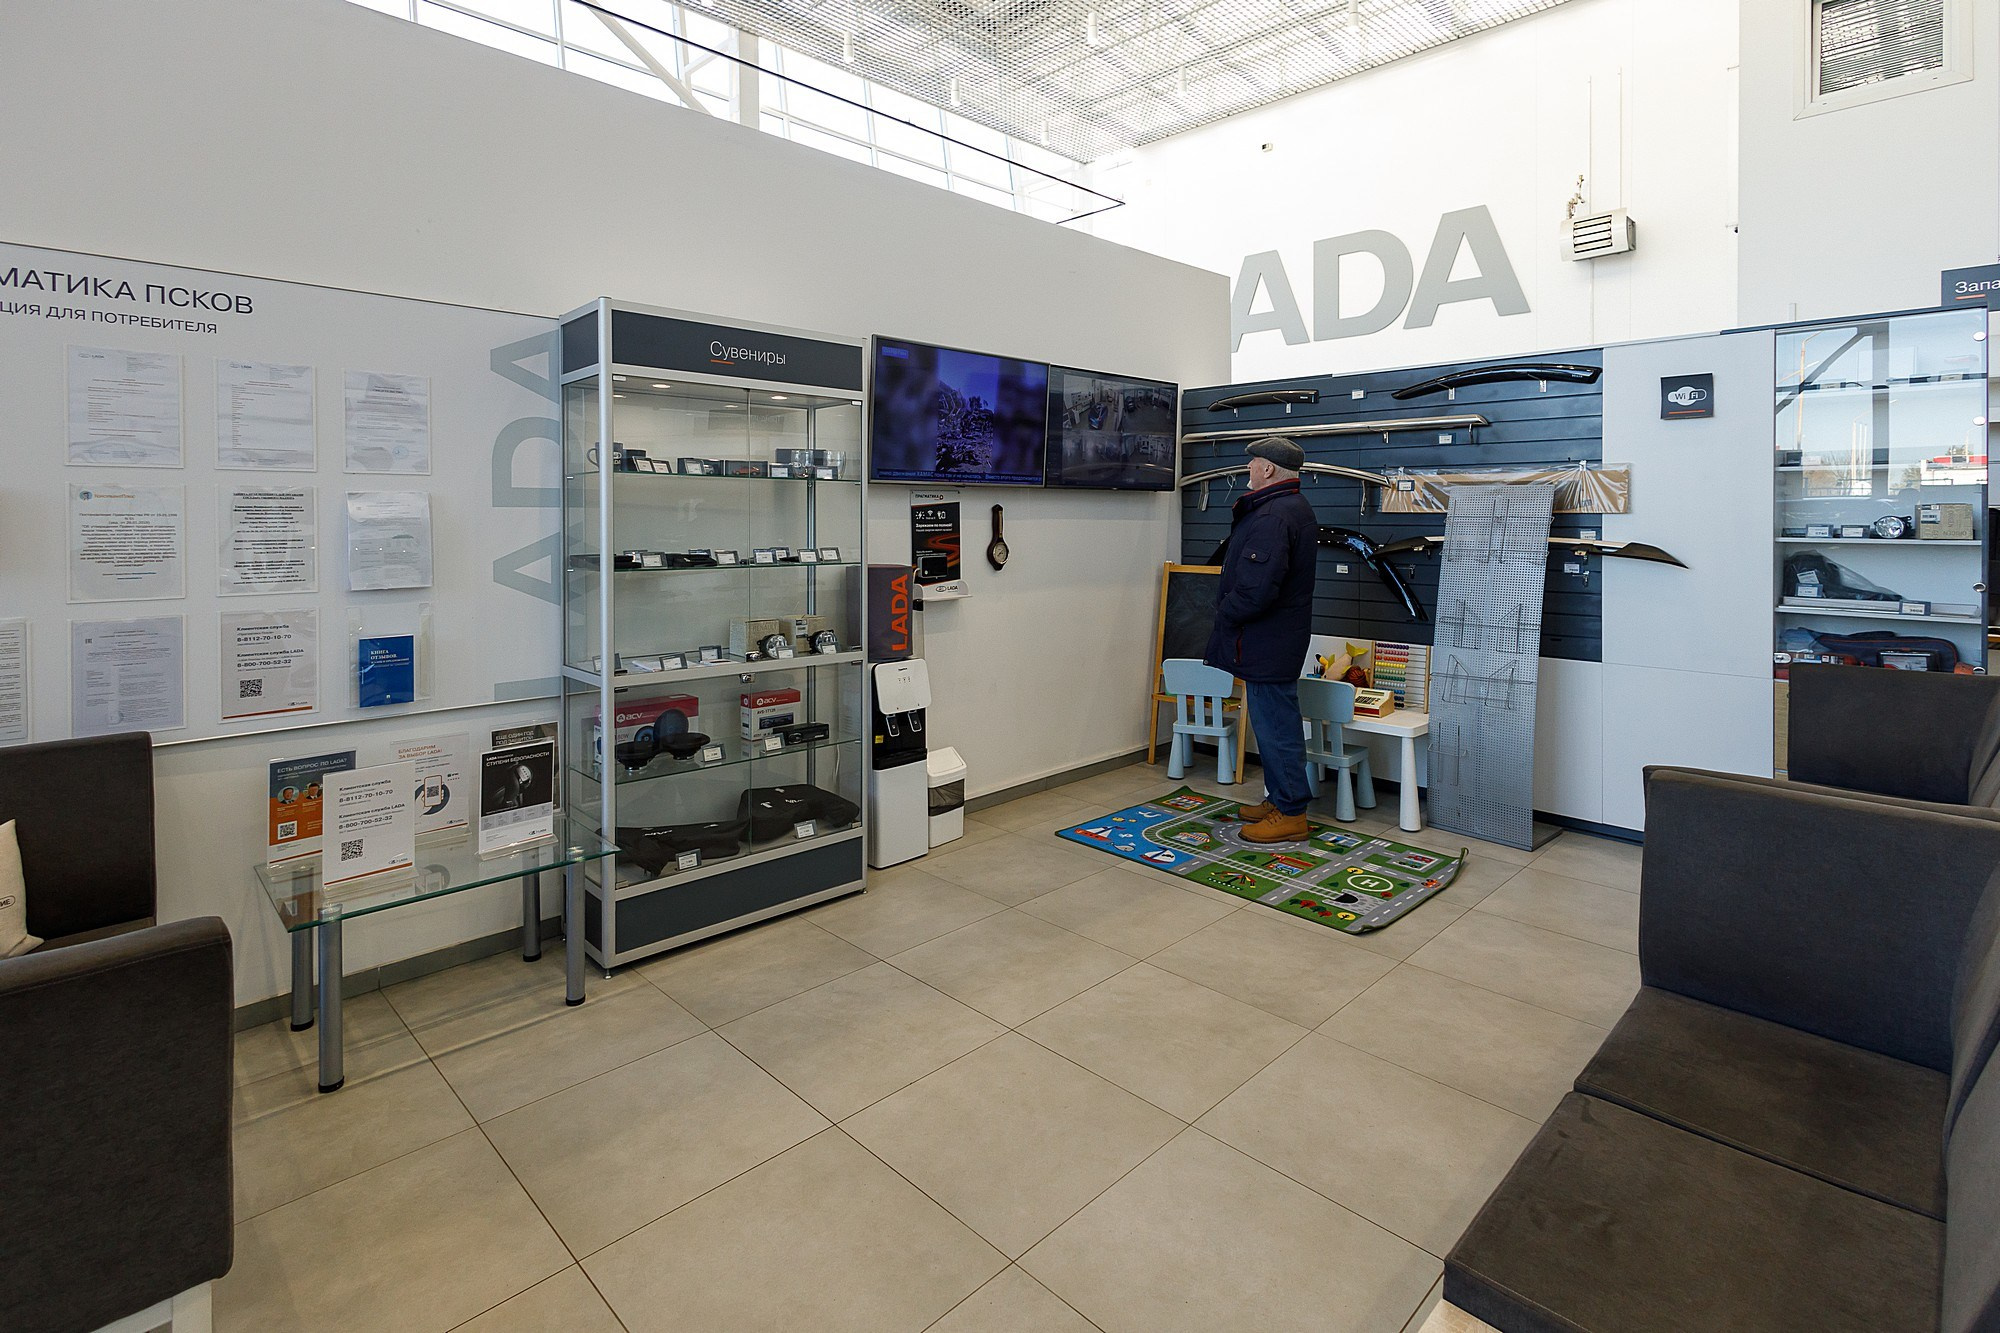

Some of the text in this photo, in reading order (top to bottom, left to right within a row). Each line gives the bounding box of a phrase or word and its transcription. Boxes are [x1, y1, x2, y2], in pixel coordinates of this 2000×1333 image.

[1955, 279, 2000, 294] Запа
[146, 284, 253, 314] ПСКОВ
[46, 306, 86, 320] ДЛЯ
[92, 311, 217, 334] ПОТРЕБИТЕЛЯ
[710, 341, 786, 366] Сувениры
[891, 574, 909, 651] LADA
[237, 634, 292, 642] 8-8112-70-10-70
[237, 659, 292, 668] 8-800-700-52-32
[486, 751, 550, 767] СТУПЕНИ БЕЗОПАСНОСТИ
[294, 762, 319, 771] ВОПРОС
[339, 783, 371, 791] Клиентская
[339, 789, 393, 803] 8-8112-70-10-70
[339, 810, 371, 819] Клиентская
[339, 815, 393, 829] 8-800-700-52-32
